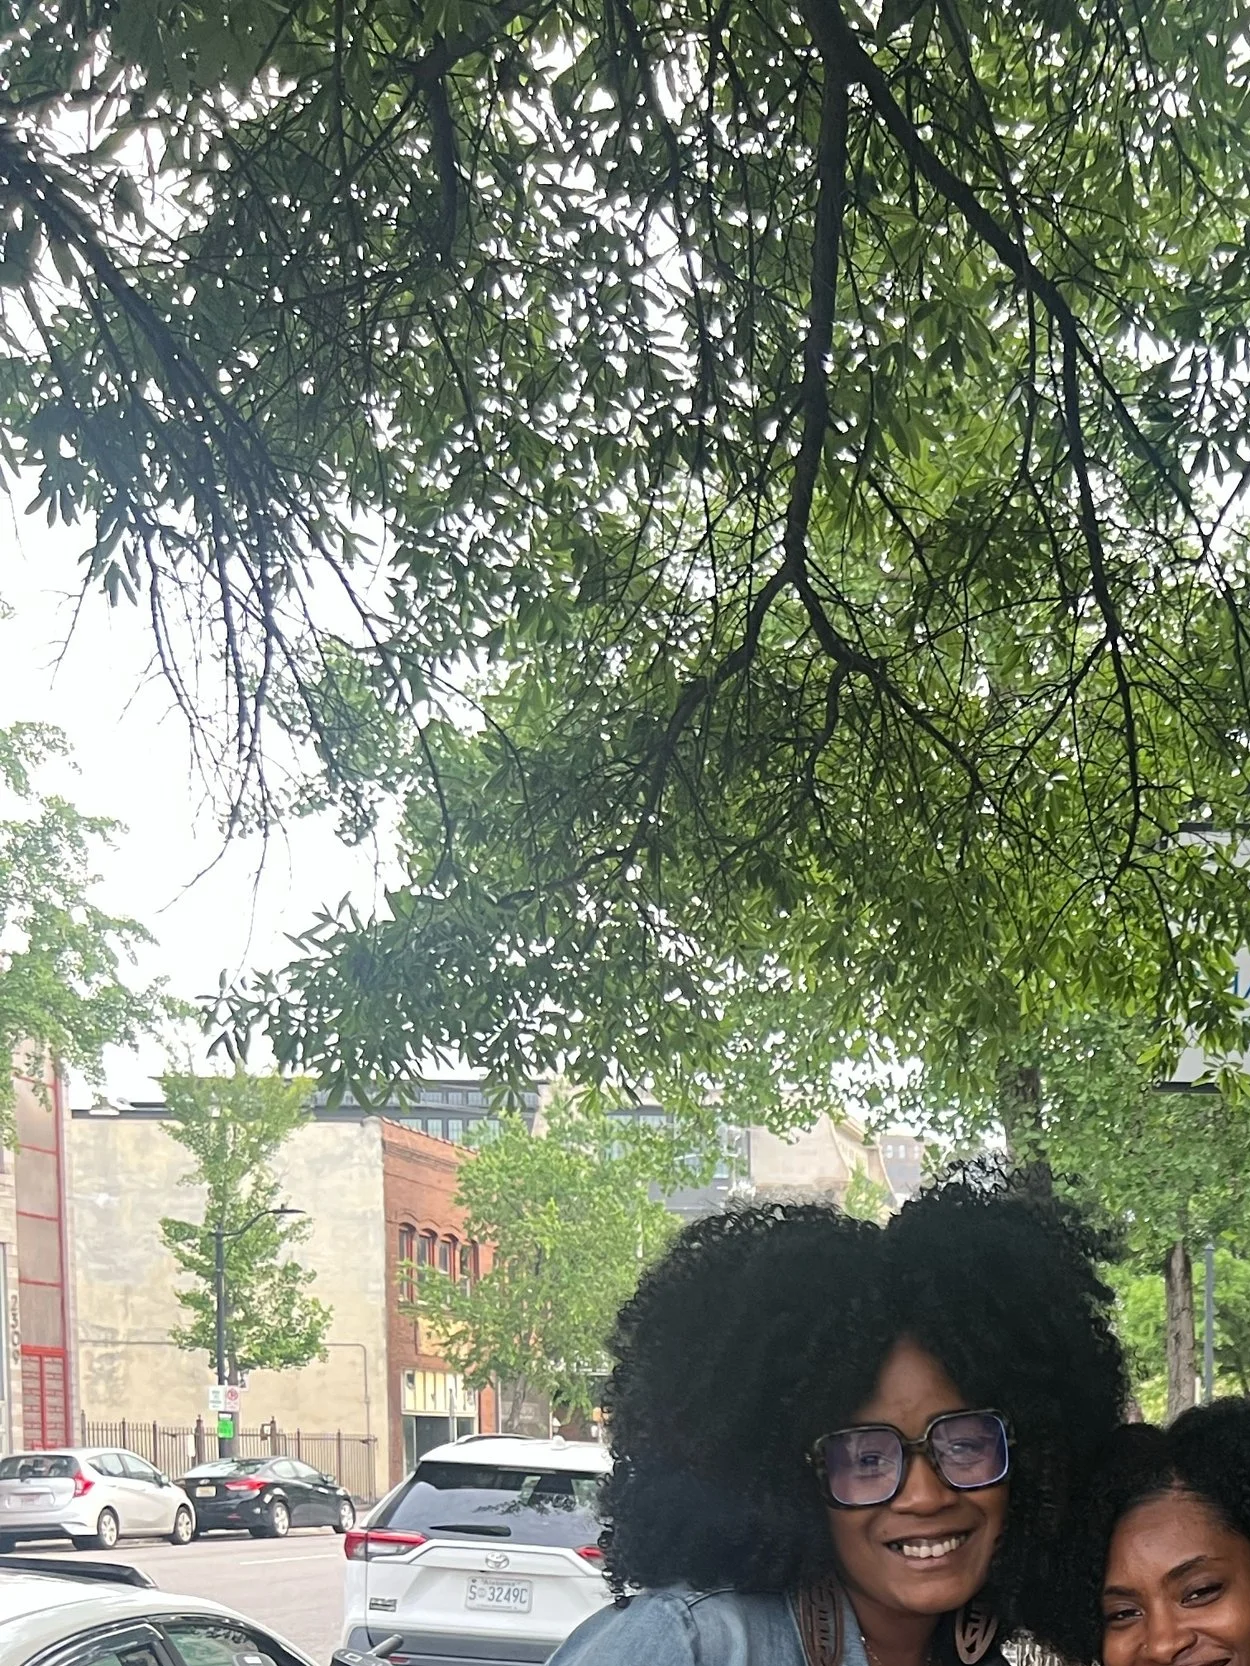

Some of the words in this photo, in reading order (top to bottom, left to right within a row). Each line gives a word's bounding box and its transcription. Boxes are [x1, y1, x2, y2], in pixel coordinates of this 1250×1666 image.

[10, 1294, 21, 1366] 2309
[468, 1584, 478, 1601] S
[487, 1586, 529, 1604] 3249C
